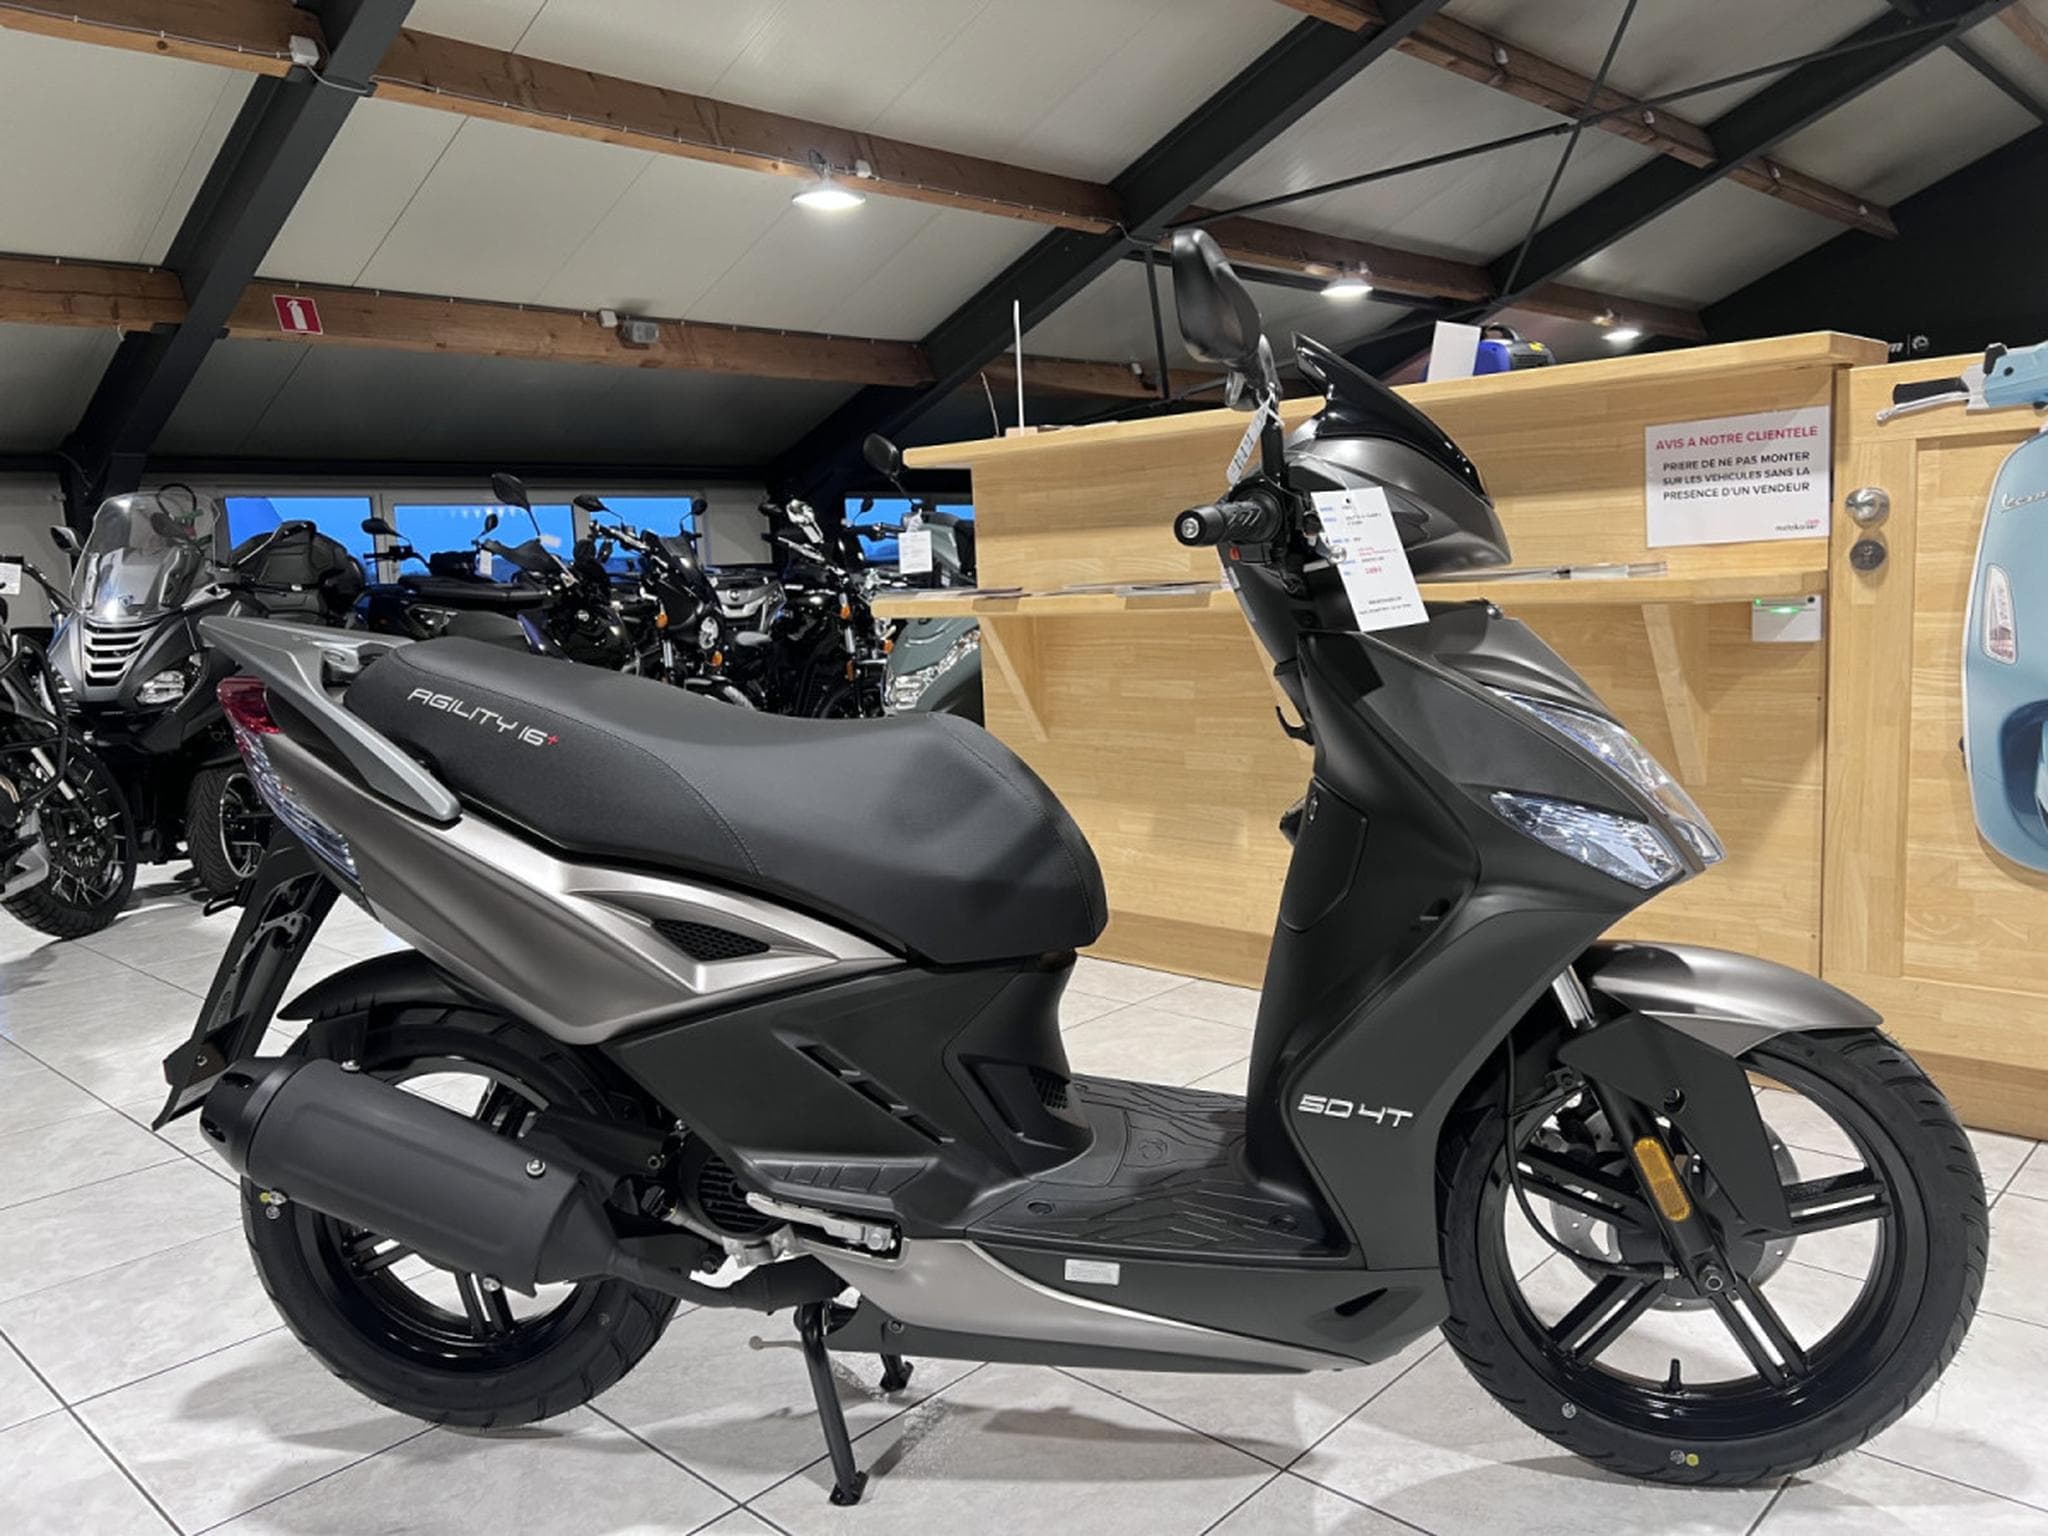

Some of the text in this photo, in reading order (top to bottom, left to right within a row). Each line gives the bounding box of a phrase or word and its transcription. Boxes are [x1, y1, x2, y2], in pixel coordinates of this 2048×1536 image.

[1656, 426, 1818, 450] AVIS A NOTRE CLIENTELE
[1663, 451, 1810, 472] PRIERE DE NE PAS MONTER
[1663, 466, 1811, 486] SUR LES VEHICULES SANS LA
[1663, 482, 1810, 500] PRESENCE D'UN VENDEUR
[407, 688, 519, 732] AGILITY
[1297, 1093, 1414, 1128] 50 4T
